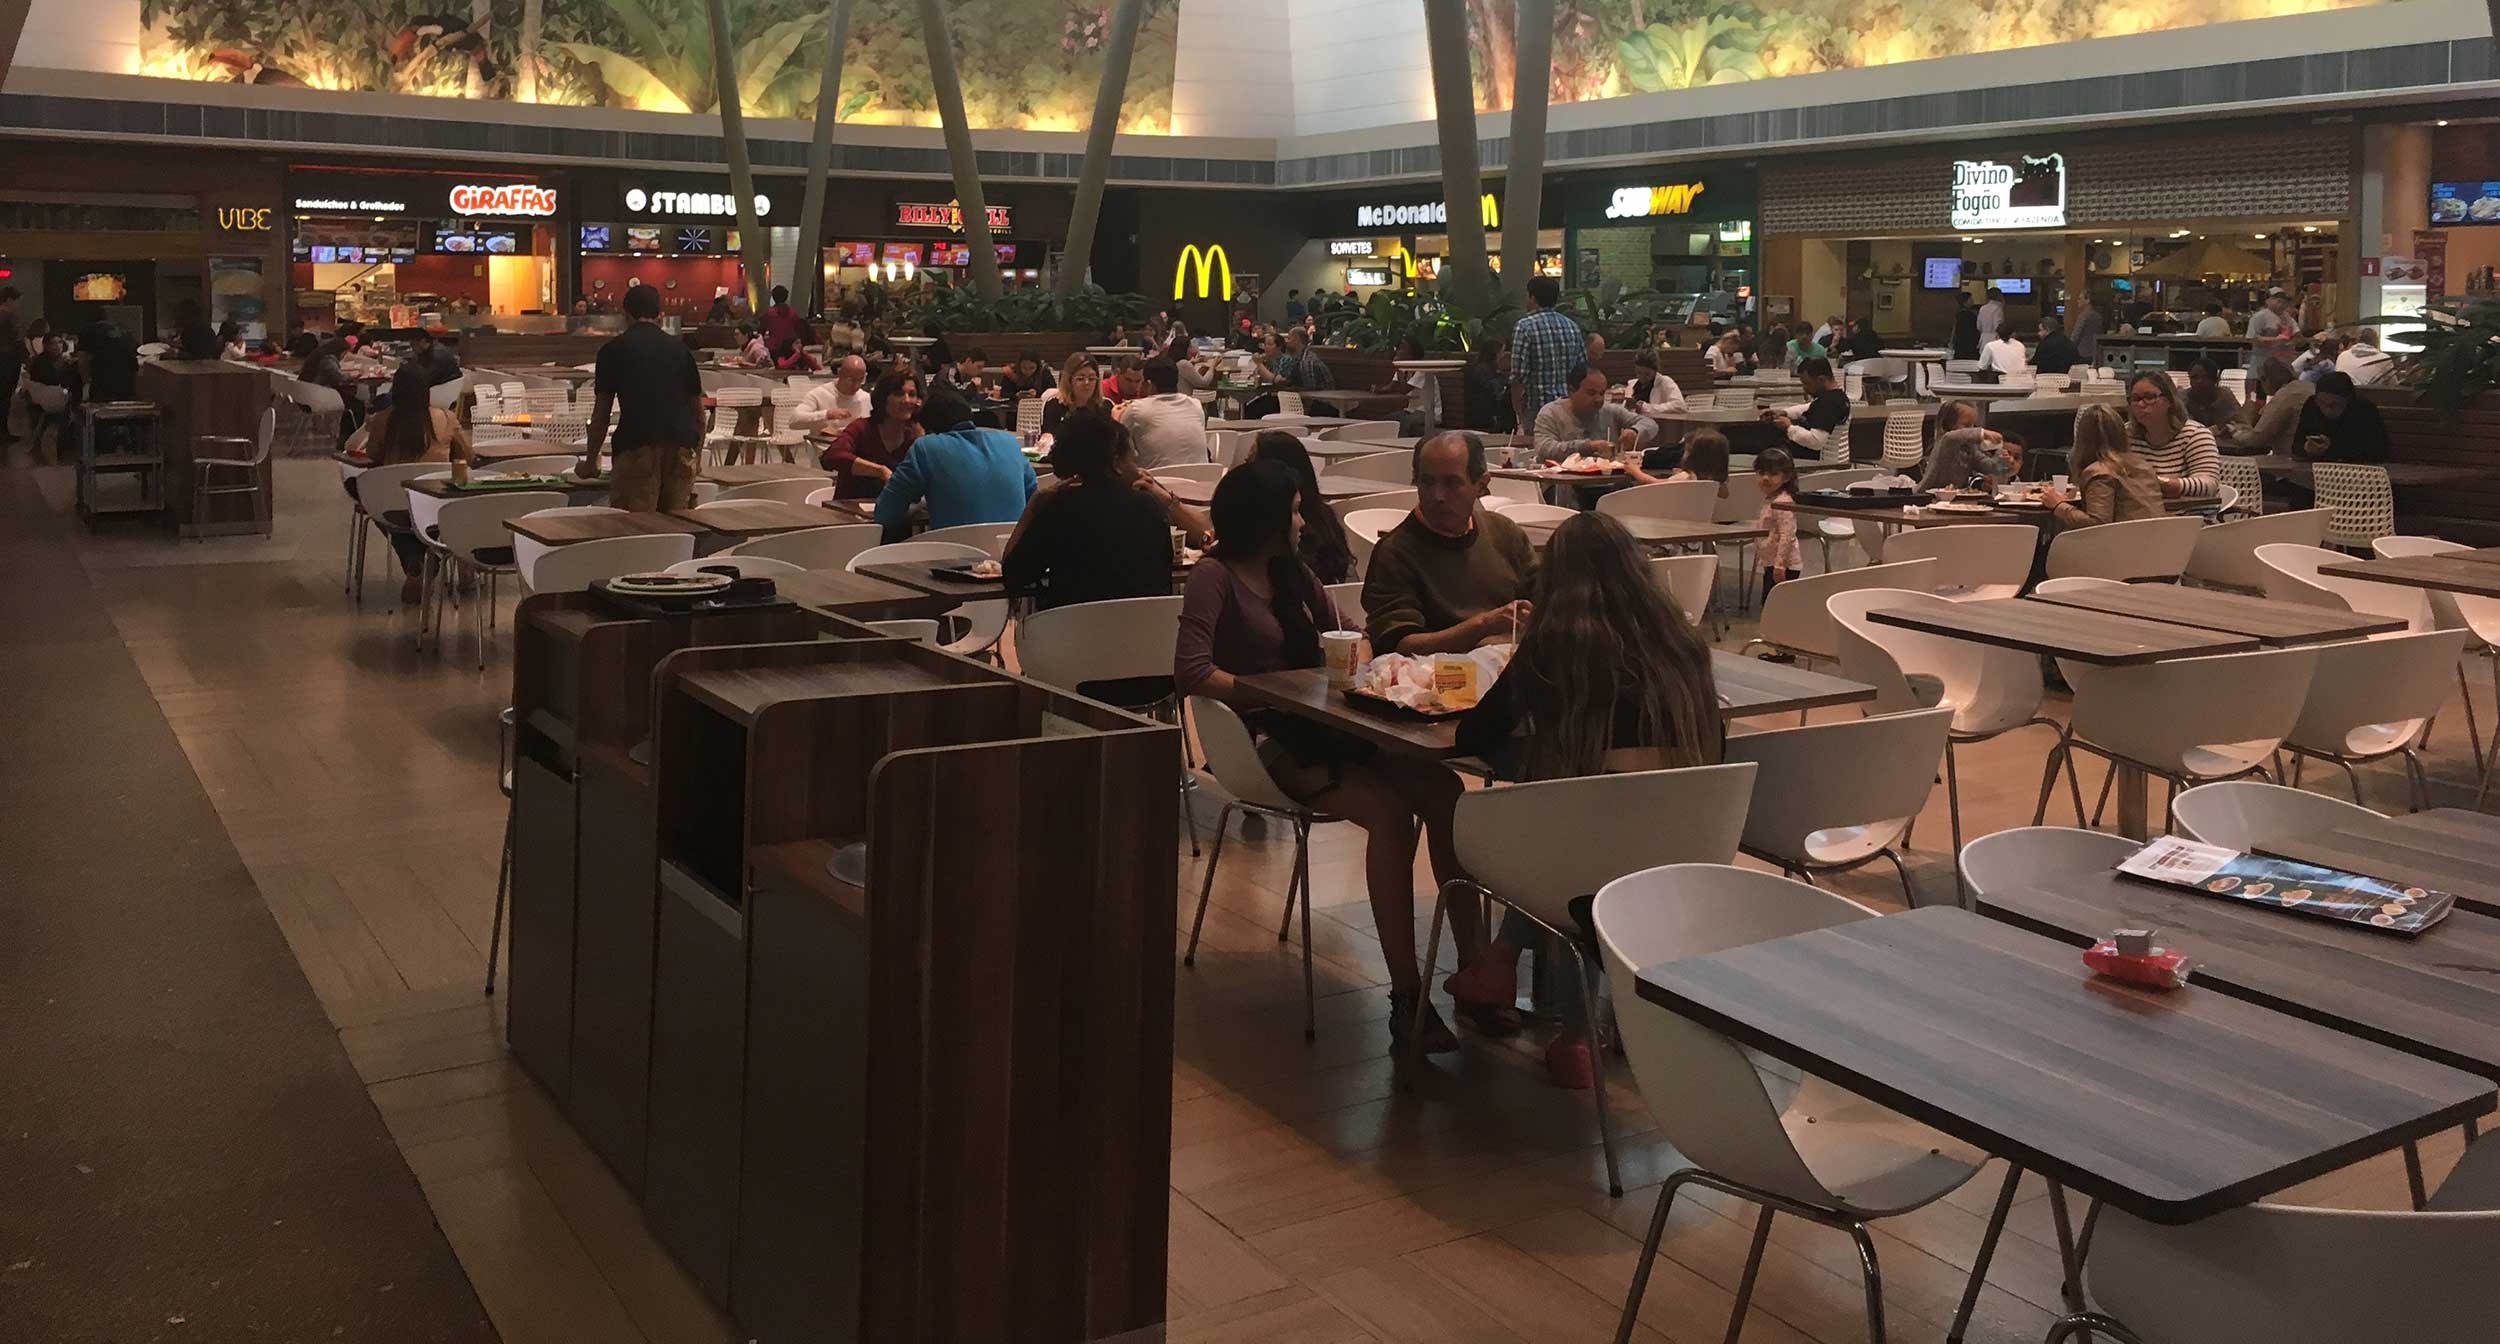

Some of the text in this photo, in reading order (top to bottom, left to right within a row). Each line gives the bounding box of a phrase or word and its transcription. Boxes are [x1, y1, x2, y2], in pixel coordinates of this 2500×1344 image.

[1952, 163, 2007, 186] Divino
[650, 191, 737, 216] STAMBU
[1605, 182, 1704, 219] SUBWAY
[1952, 188, 2000, 217] Fogão
[899, 205, 951, 224] BILLY
[1358, 202, 1447, 227] McDonald
[1953, 217, 1983, 226] COMIDA
[1331, 241, 1372, 255] SORVETES
